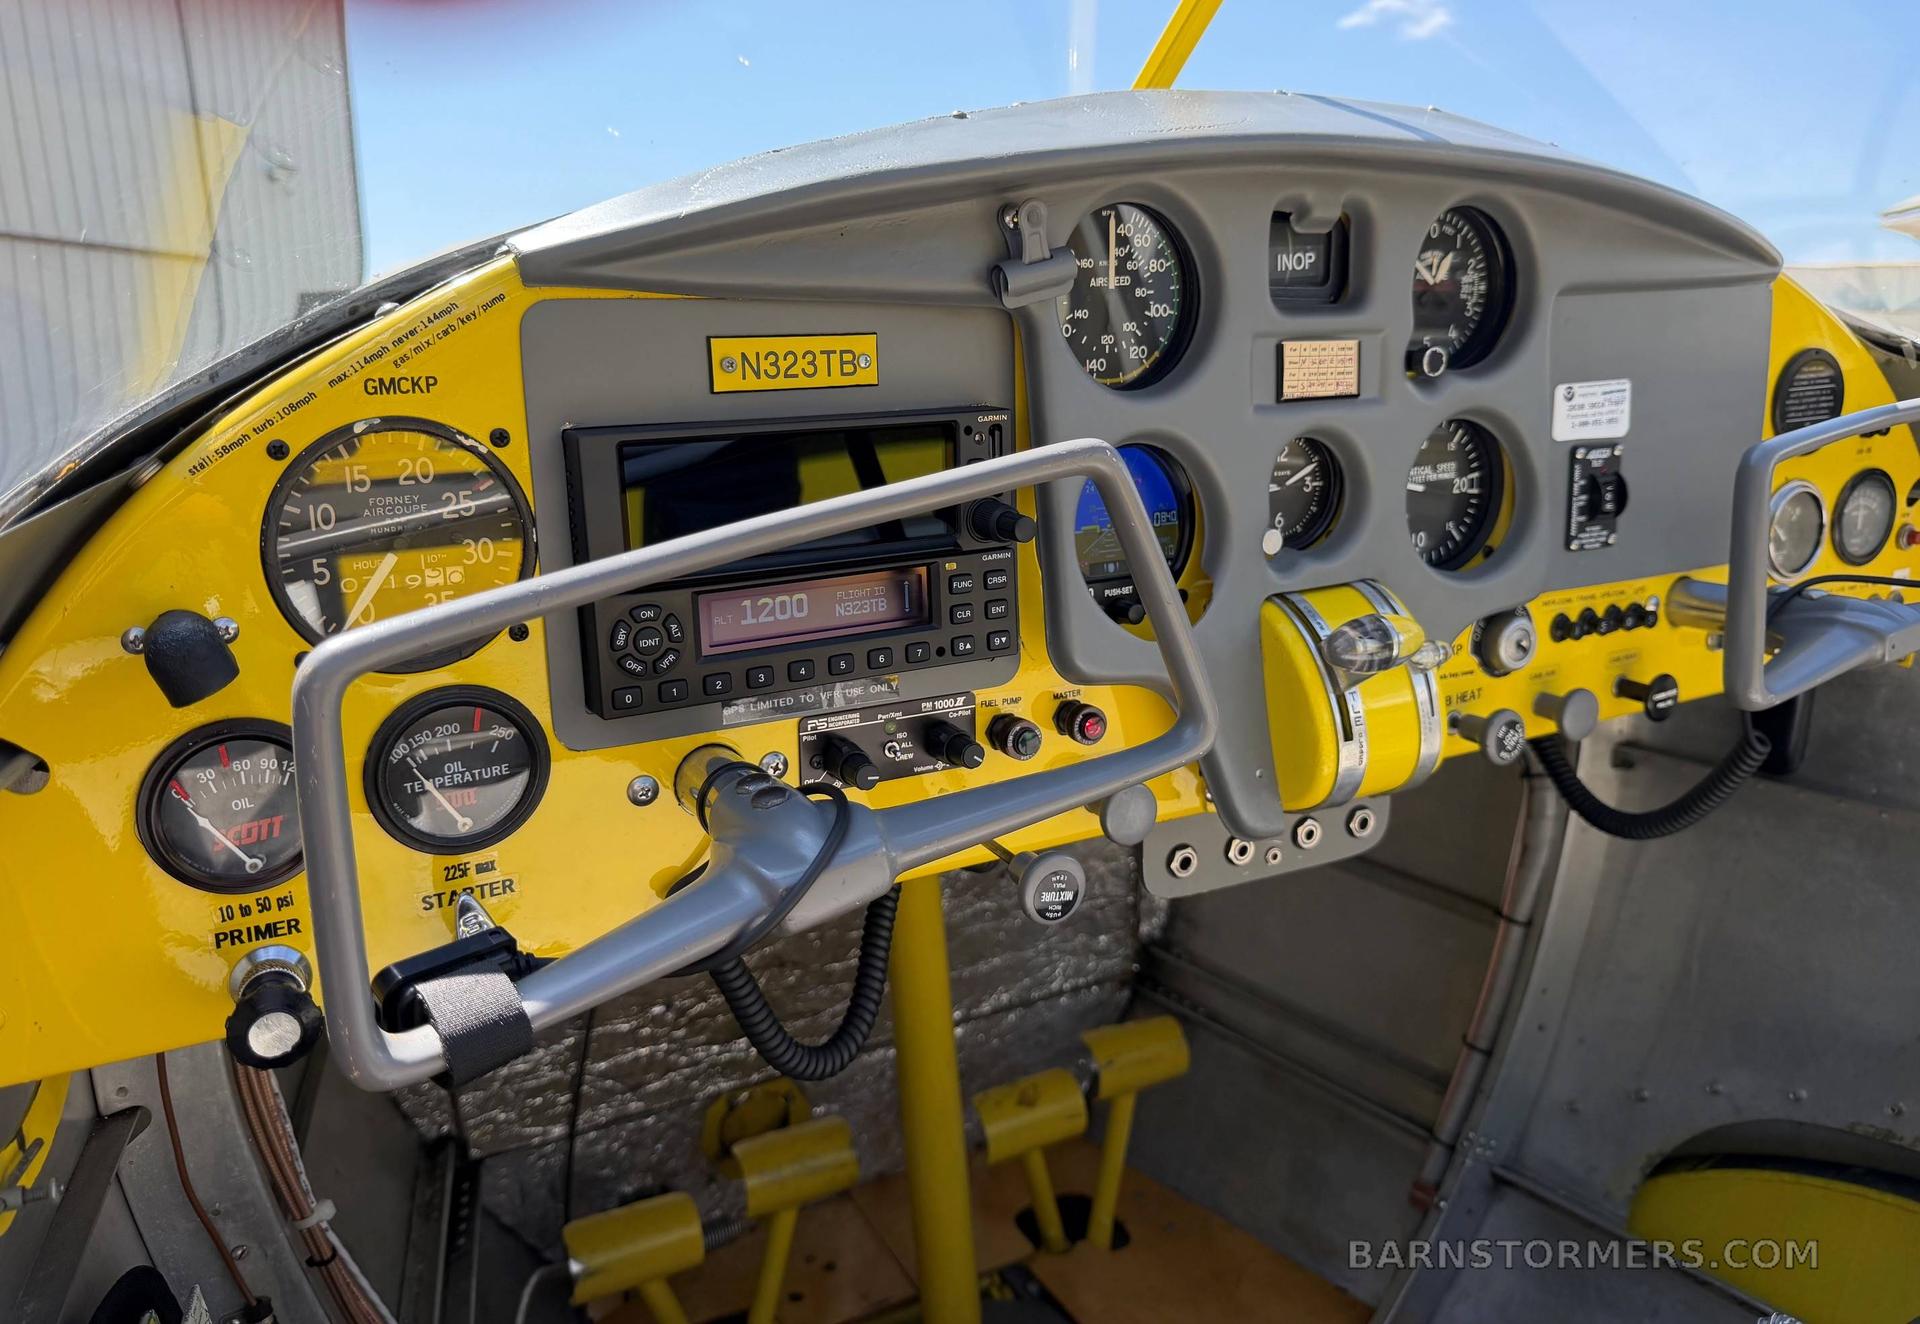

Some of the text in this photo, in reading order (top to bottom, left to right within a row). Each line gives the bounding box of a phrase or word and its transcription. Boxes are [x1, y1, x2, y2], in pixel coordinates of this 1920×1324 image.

[1117, 223, 1133, 237] 40
[1134, 234, 1150, 248] 60
[1080, 259, 1094, 268] 160
[1126, 261, 1138, 270] 60
[1149, 259, 1166, 272] 80
[1277, 252, 1316, 272] INOP
[1089, 276, 1131, 288] AIRSEED
[1135, 287, 1147, 297] 80
[1074, 309, 1089, 319] 140
[1150, 304, 1169, 317] 100
[1122, 322, 1136, 331] 100
[1101, 335, 1114, 344] 120
[1129, 346, 1148, 359] 120
[740, 349, 859, 381] N323TB
[1086, 359, 1106, 372] 140
[188, 302, 459, 477] stall:58mph turb:108mph max:114mph never:144mph
[364, 376, 438, 396] GMCKP
[977, 414, 1008, 423] GARMIN
[398, 457, 434, 485] 20
[345, 466, 371, 493] 15
[1303, 478, 1313, 492] 3
[1452, 477, 1468, 494] 20
[369, 495, 420, 507] FORNEY
[442, 491, 476, 519] 25
[363, 504, 428, 517] AIRCOUPE
[309, 503, 336, 532] 10
[1275, 512, 1284, 528] 6
[462, 538, 494, 565] 30
[982, 552, 1011, 561] GARMIN
[312, 558, 331, 586] 5
[953, 580, 973, 588] FUNC
[987, 576, 1007, 584] CRSR
[836, 586, 886, 600] FLIGHT ID
[1104, 585, 1134, 598] PUSH-SET
[740, 593, 809, 625] 1200
[835, 598, 888, 617] N323TB
[957, 610, 971, 618] CLR
[991, 606, 1005, 614] ENT
[640, 610, 654, 619] ON
[714, 616, 734, 625] ALT
[616, 628, 627, 646] SBY
[670, 624, 681, 638] ALT
[640, 637, 660, 647] IDNT
[959, 643, 965, 651] 8
[994, 638, 1000, 646] 9
[878, 653, 885, 663] 6
[916, 648, 922, 657] 7
[626, 660, 643, 673] OFF
[660, 654, 676, 669] VFR
[839, 659, 846, 668] 5
[799, 666, 805, 675] 4
[758, 673, 765, 682] 3
[716, 680, 722, 689] 2
[672, 687, 677, 696] 1
[750, 698, 794, 711] LIMITED
[799, 694, 815, 703] TO
[820, 690, 840, 701] VFR
[846, 686, 865, 697] USE
[870, 682, 898, 694] ONLY
[1053, 689, 1081, 700] MASTER
[1456, 688, 1483, 705] HEAT
[625, 694, 632, 704] 0
[980, 697, 1022, 708] FUEL PUMP
[948, 710, 971, 718] Co-Pilot
[435, 722, 460, 738] 200
[489, 724, 514, 741] 250
[408, 729, 432, 749] 150
[803, 734, 817, 742] Pilot
[389, 743, 410, 766] 100
[232, 759, 250, 772] 60
[260, 758, 278, 769] 90
[281, 760, 296, 773] 12
[444, 761, 466, 774] OIL
[913, 764, 934, 773] Volume
[197, 769, 216, 783] 30
[231, 797, 255, 811] OIL
[444, 861, 471, 882] 225F
[1040, 890, 1074, 902] MIXTURE
[218, 891, 294, 923] 10 to 50 psi
[215, 918, 302, 948] PRIMER
